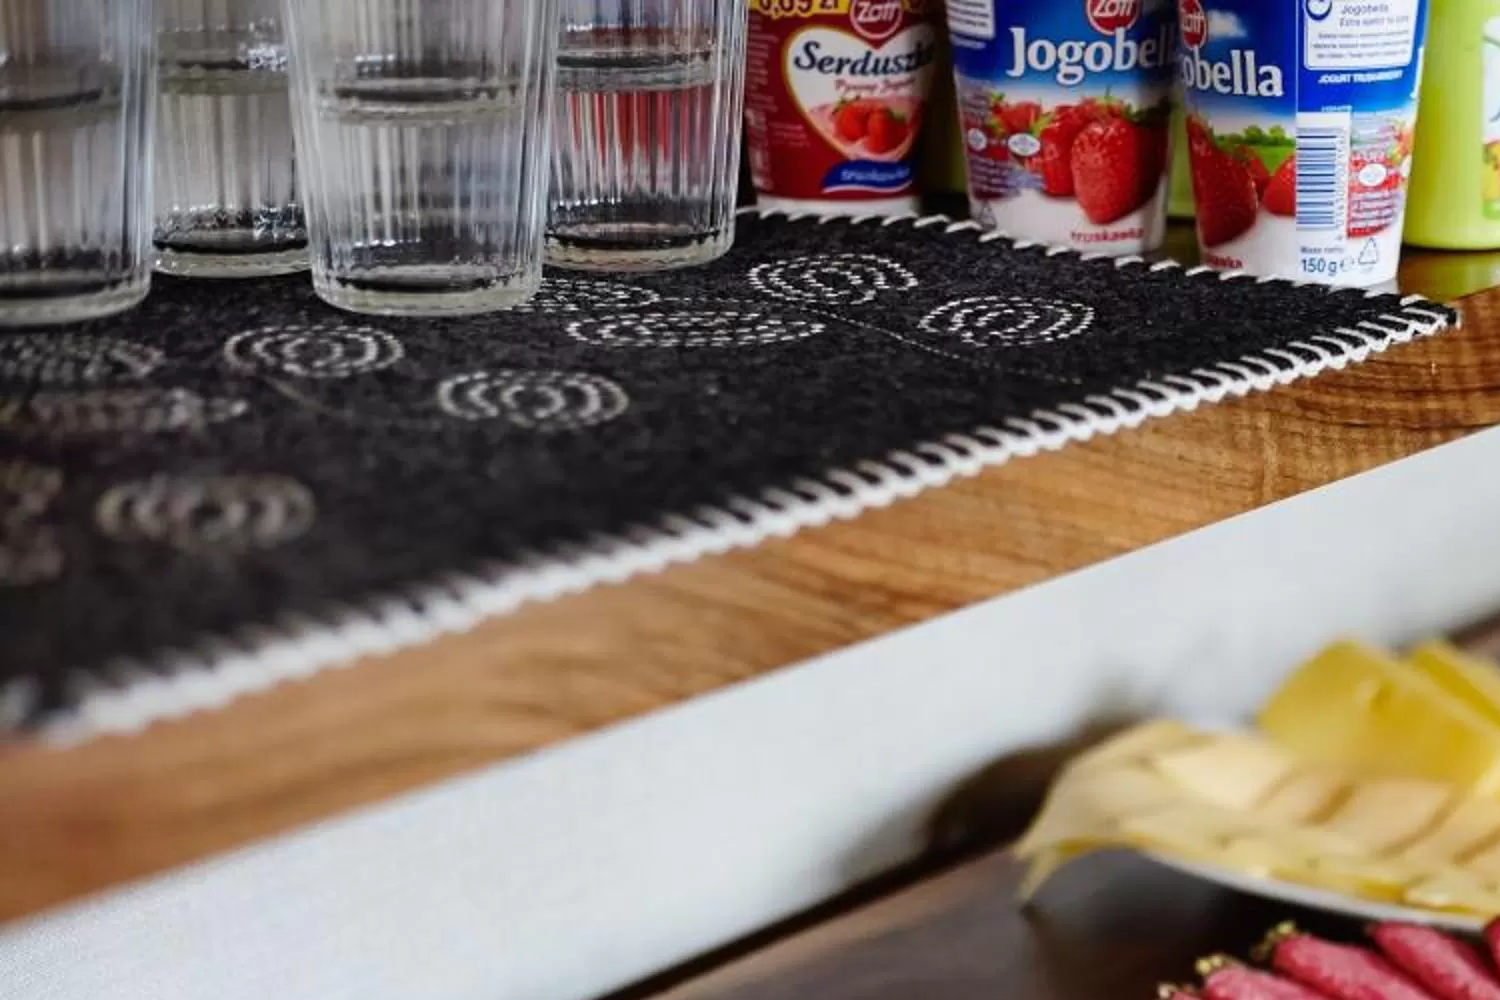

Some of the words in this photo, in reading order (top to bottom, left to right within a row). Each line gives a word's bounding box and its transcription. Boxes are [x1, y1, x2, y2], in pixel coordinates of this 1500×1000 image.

[1006, 27, 1176, 86] Jogobell
[1181, 45, 1285, 97] obella
[1302, 257, 1326, 273] 150
